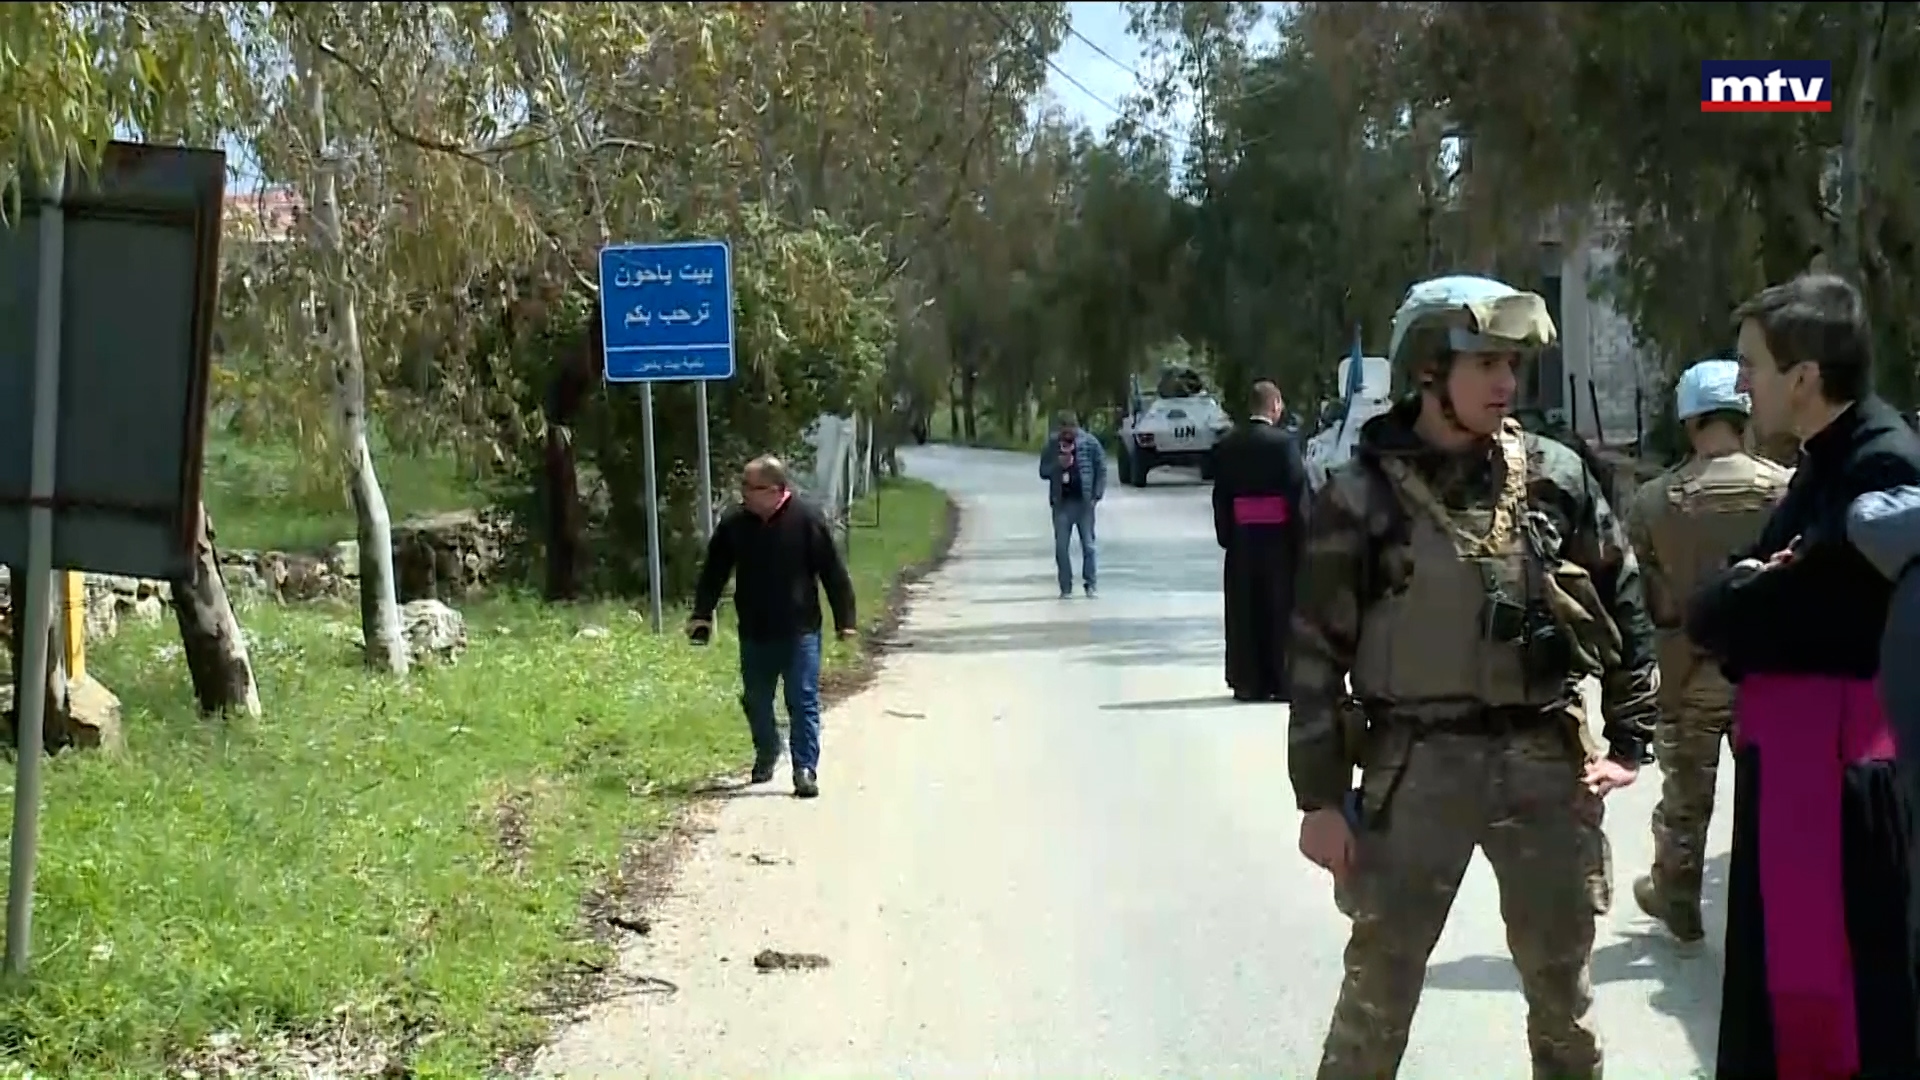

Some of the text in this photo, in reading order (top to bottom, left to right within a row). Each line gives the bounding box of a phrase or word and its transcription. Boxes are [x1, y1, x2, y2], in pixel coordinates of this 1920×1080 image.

[614, 263, 714, 287] بيت ياحون
[624, 301, 711, 330] ترحب بكم
[1174, 424, 1196, 439] UN
